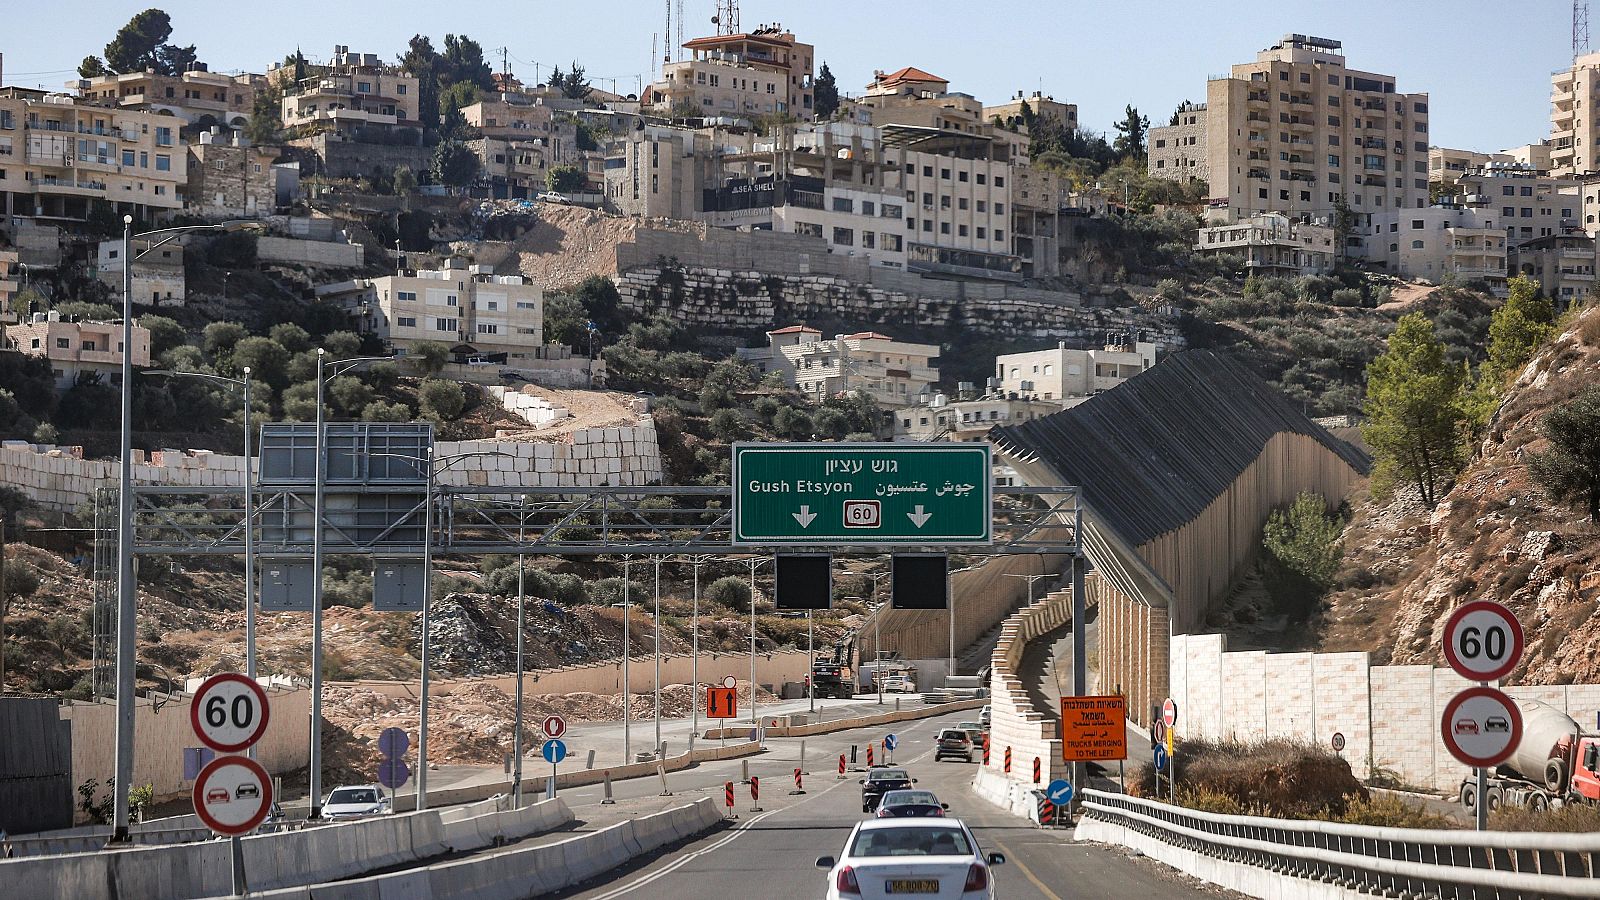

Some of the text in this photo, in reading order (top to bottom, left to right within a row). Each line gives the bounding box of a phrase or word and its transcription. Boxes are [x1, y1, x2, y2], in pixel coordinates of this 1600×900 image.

[738, 183, 775, 193] SEA SHELL
[753, 207, 770, 216] GYM
[825, 459, 898, 476] גוש עציון
[749, 480, 853, 496] Gush Etsyon
[875, 481, 928, 497] عتسيون
[853, 508, 872, 520] 60
[1460, 626, 1506, 661] 60
[1064, 700, 1122, 709] משאיות משתלבות
[206, 694, 253, 729] 60
[1081, 712, 1105, 720] משמאל
[1067, 739, 1122, 748] TRUCKS MERGING
[1086, 749, 1097, 757] THE
